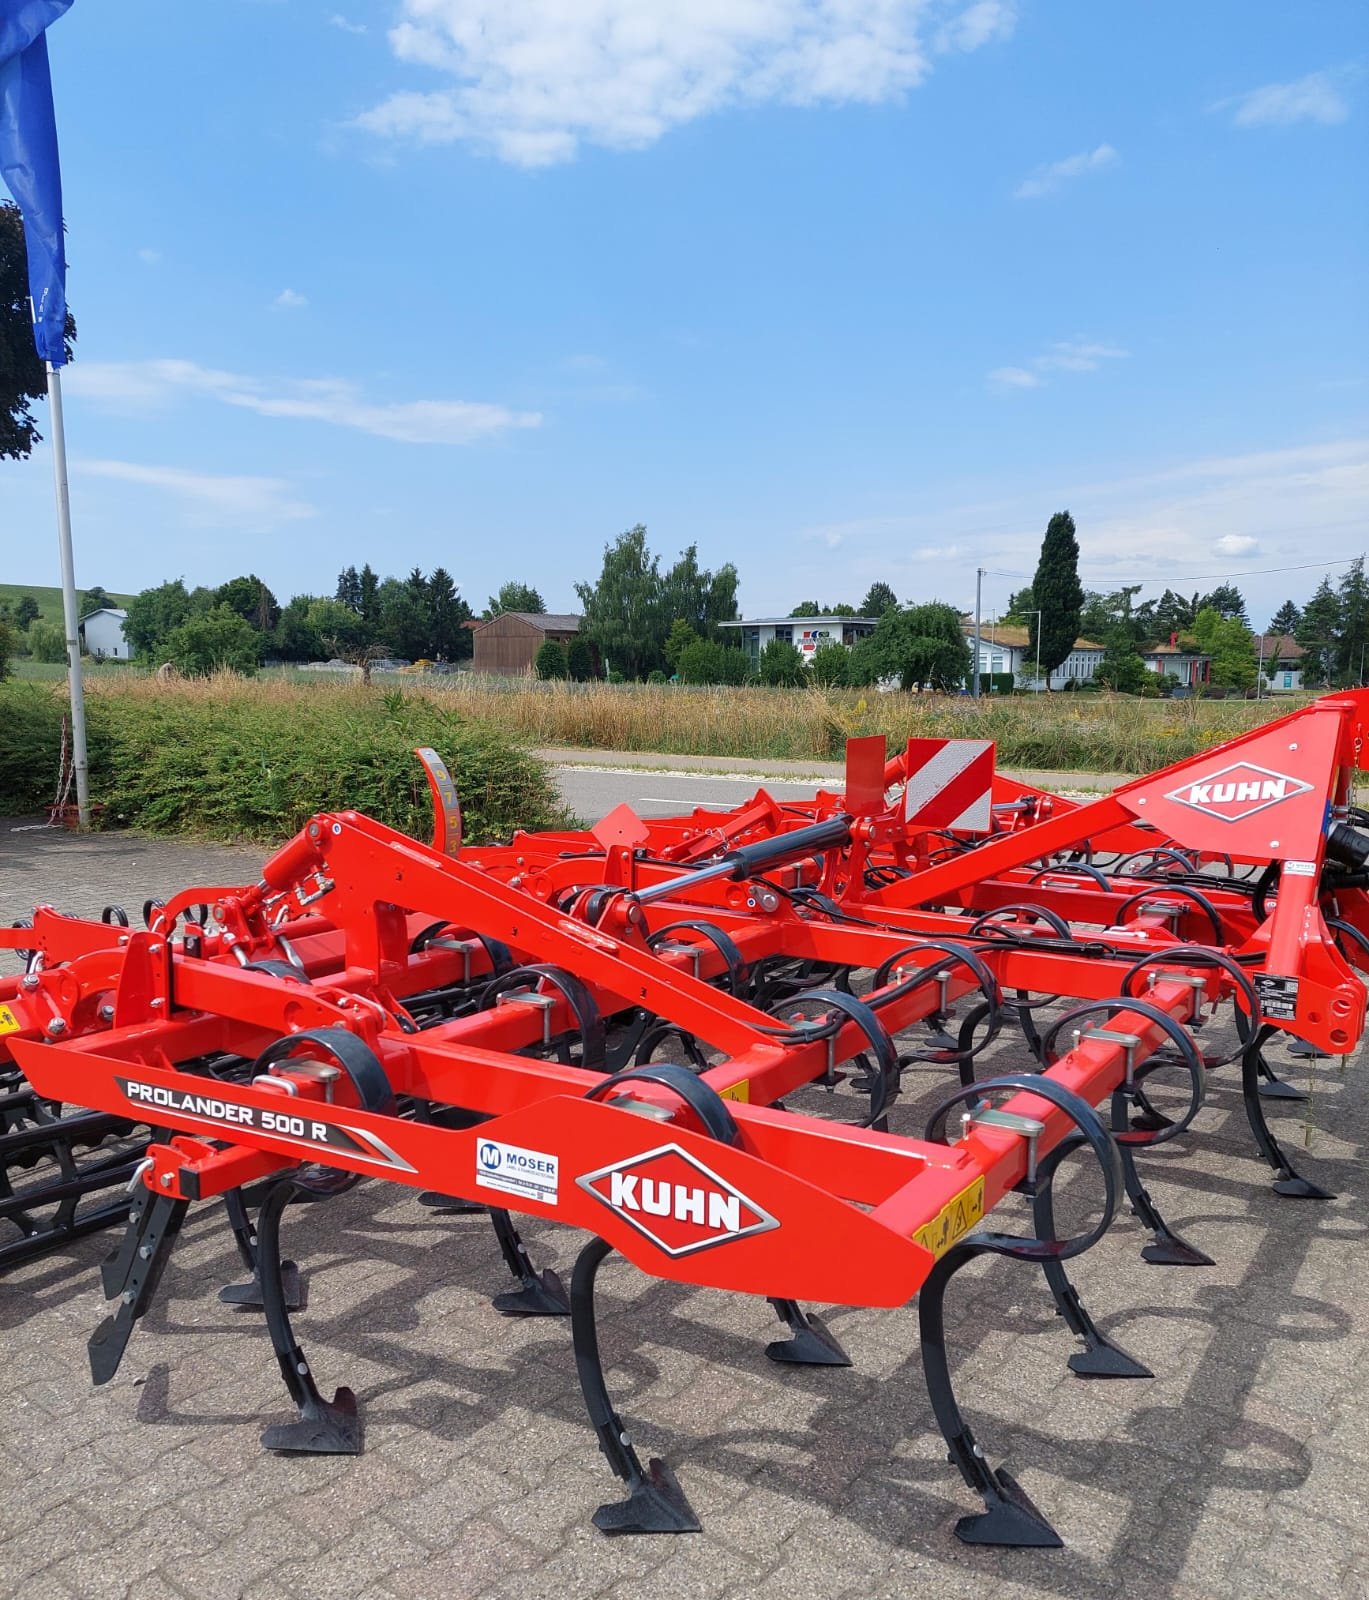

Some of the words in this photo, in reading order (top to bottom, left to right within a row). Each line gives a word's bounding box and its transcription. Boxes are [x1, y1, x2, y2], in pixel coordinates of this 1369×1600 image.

[444, 791, 452, 804] 7
[1189, 779, 1286, 804] KUHN
[449, 815, 457, 829] 5
[127, 1081, 253, 1126] PROLANDER
[261, 1112, 304, 1137] 500
[311, 1122, 328, 1142] R
[506, 1153, 555, 1174] MOSER
[610, 1171, 740, 1233] KUHN
